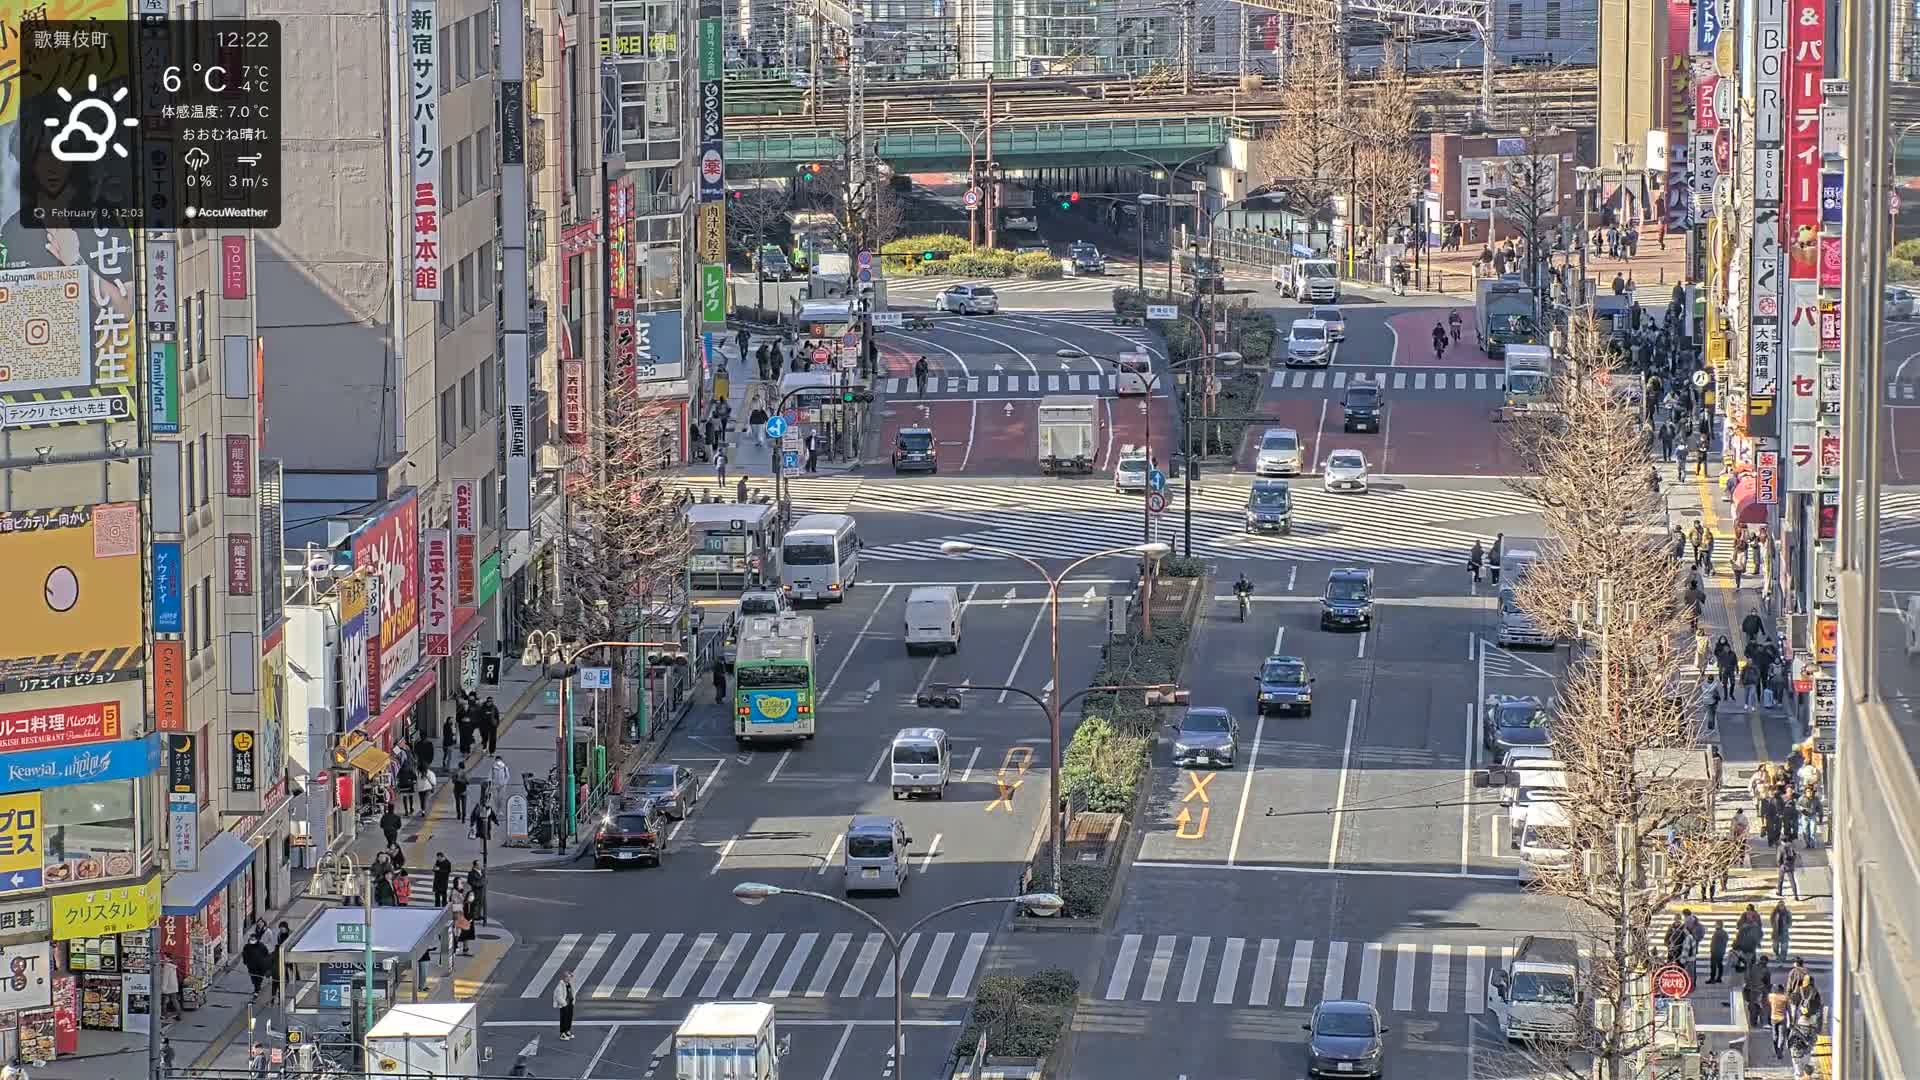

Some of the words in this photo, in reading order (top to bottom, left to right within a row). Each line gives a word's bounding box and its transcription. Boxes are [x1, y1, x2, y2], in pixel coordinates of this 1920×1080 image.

[412, 9, 434, 168] 新宿サンパーク
[1702, 86, 1713, 117] アコム
[1765, 150, 1775, 198] ESOLA
[415, 182, 437, 289] 三平本館
[706, 273, 719, 312] レイク
[154, 322, 171, 332] 3F
[1755, 327, 1769, 379] 大衆酒場
[153, 351, 165, 413] FamilyMart
[10, 407, 44, 419] テンクリ
[50, 403, 107, 417] たいせい先生
[456, 484, 468, 529] GAME
[157, 552, 168, 603] ゲウチャイ
[429, 540, 445, 627] 三平ストア
[19, 673, 115, 692] リアエイドビジョン
[21, 733, 65, 745] RESTAURANT
[1, 908, 35, 930] 囲碁
[65, 901, 138, 925] クリスタル
[322, 988, 340, 1002] 12
